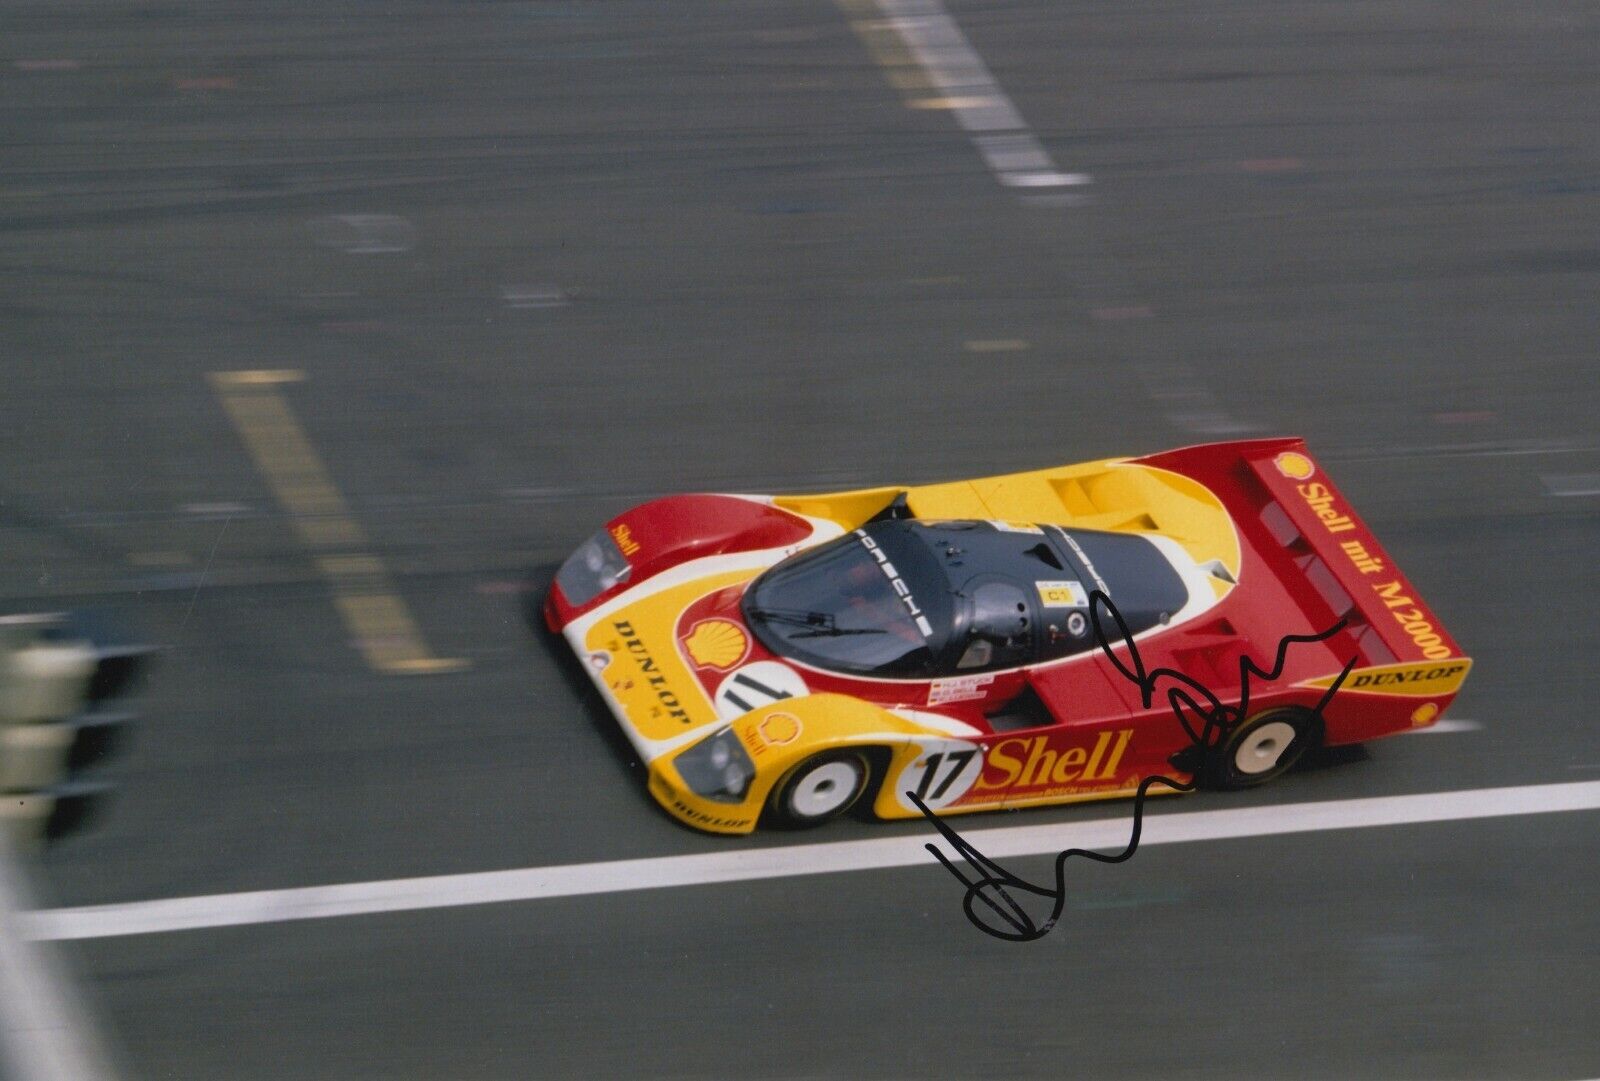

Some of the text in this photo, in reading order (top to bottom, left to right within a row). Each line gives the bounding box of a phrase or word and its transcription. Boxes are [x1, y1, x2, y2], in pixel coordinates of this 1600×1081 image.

[611, 524, 641, 556] Shell
[1297, 482, 1356, 534] Shell
[1340, 540, 1385, 575] mit
[614, 621, 691, 724] DUNLOP
[1352, 666, 1464, 687] DUNLOP
[916, 746, 982, 800] 17
[972, 729, 1134, 790] Shell
[673, 800, 752, 827] DUNLOP
